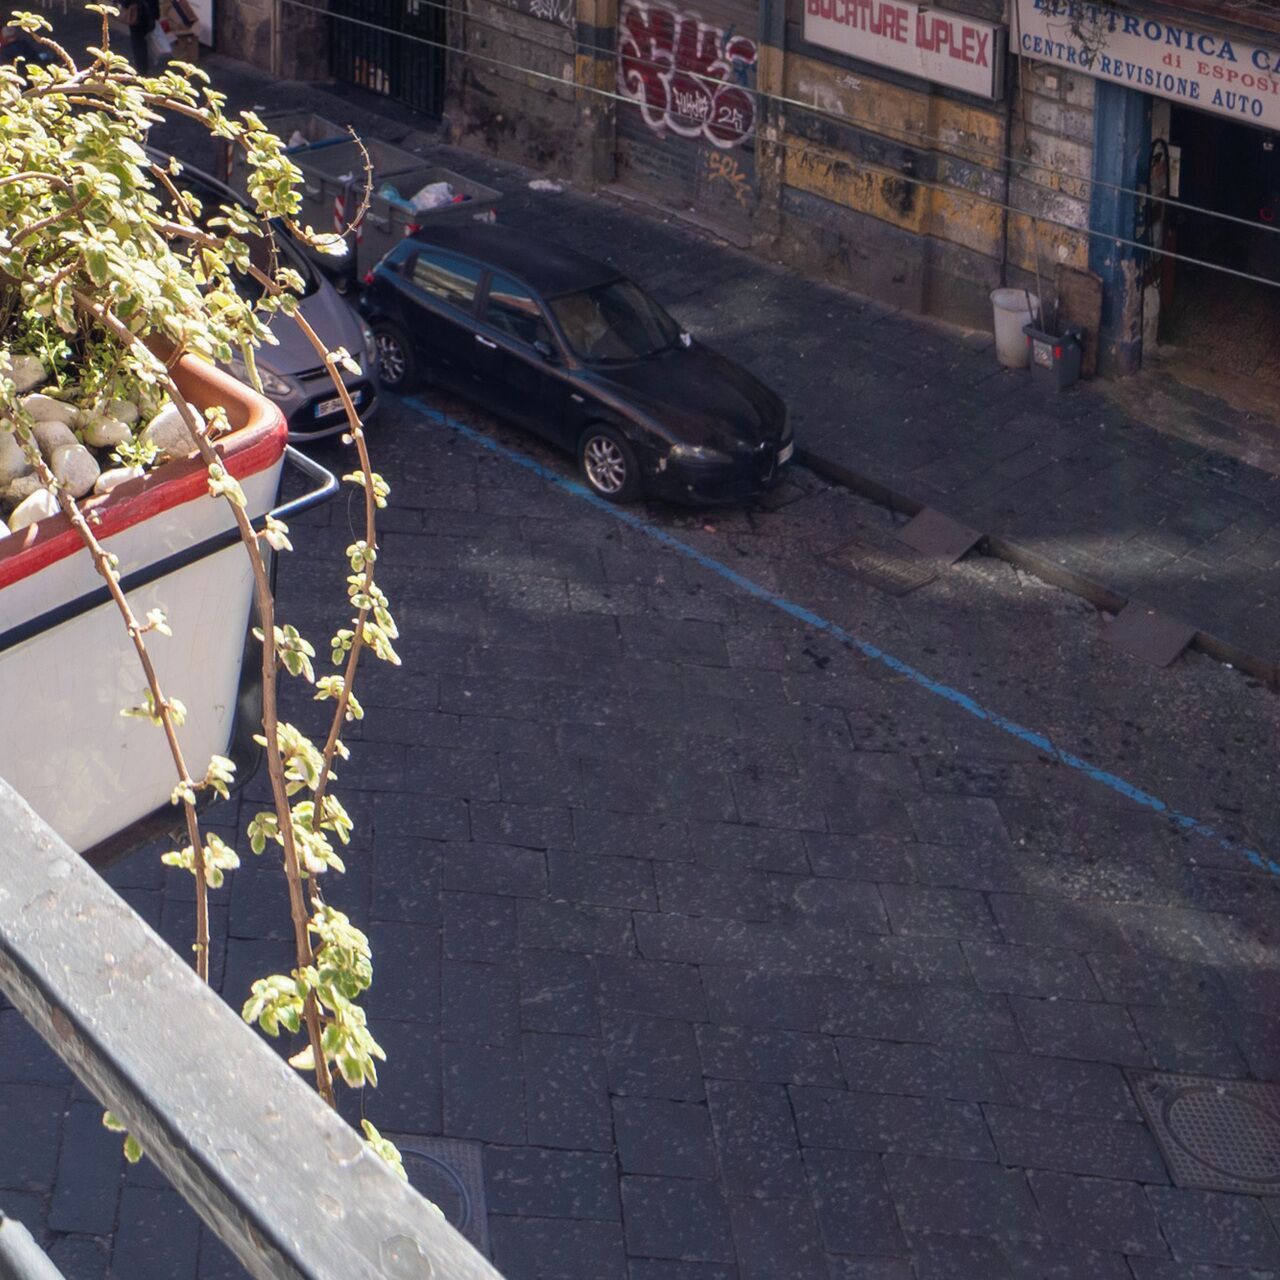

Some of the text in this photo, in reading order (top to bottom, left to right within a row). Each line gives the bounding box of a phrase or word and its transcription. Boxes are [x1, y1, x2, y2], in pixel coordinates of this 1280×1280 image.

[1021, 32, 1090, 67] CENTRO
[1100, 53, 1201, 100] REVISIONE
[1211, 87, 1263, 118] AUTO
[1162, 52, 1183, 69] di
